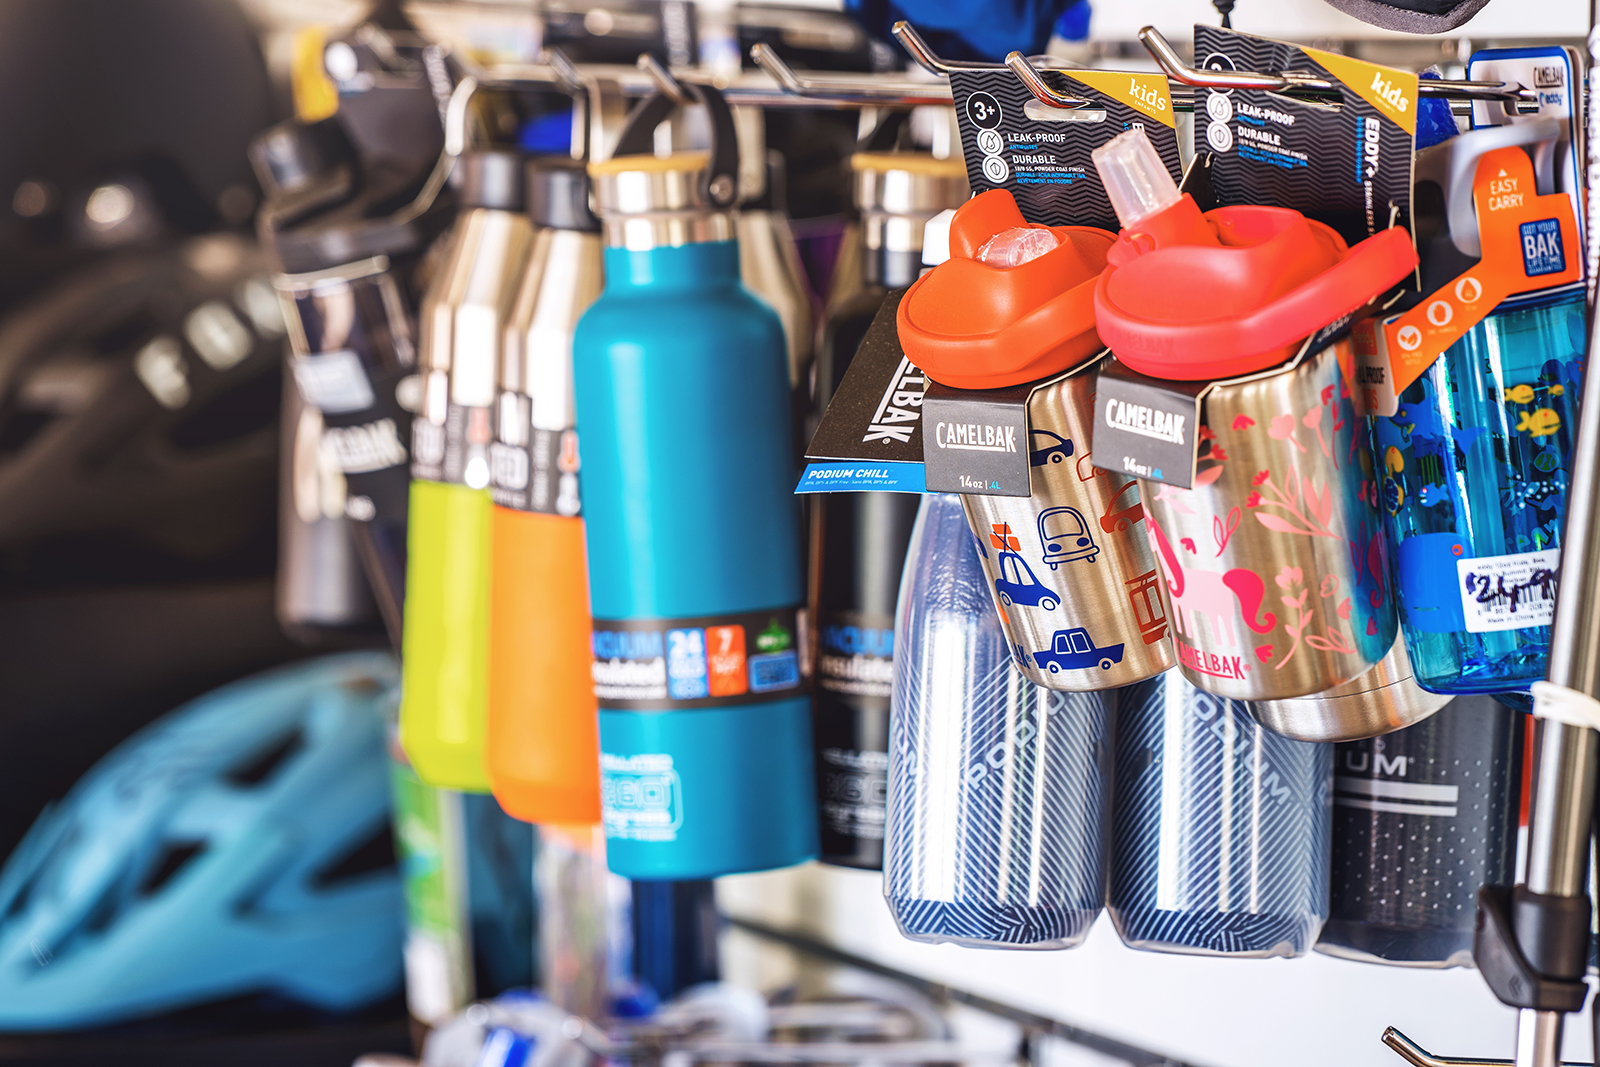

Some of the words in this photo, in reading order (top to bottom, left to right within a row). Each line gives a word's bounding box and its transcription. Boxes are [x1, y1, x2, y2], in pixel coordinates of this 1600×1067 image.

[1129, 78, 1166, 110] kids
[1371, 72, 1409, 112] kids
[974, 101, 996, 120] 3+
[1237, 102, 1295, 126] LEAK-PROOF
[1007, 133, 1066, 143] LEAK-PROOF
[1237, 125, 1281, 146] DURABLE
[1012, 155, 1057, 164] DURABLE
[1490, 177, 1519, 195] EASY
[1488, 193, 1524, 211] CARRY
[1523, 231, 1560, 259] BAK
[1105, 398, 1186, 446] CAMELBAK
[936, 422, 1017, 453] CAMELBAK
[807, 469, 854, 479] PODIUM
[855, 469, 889, 478] CHILL
